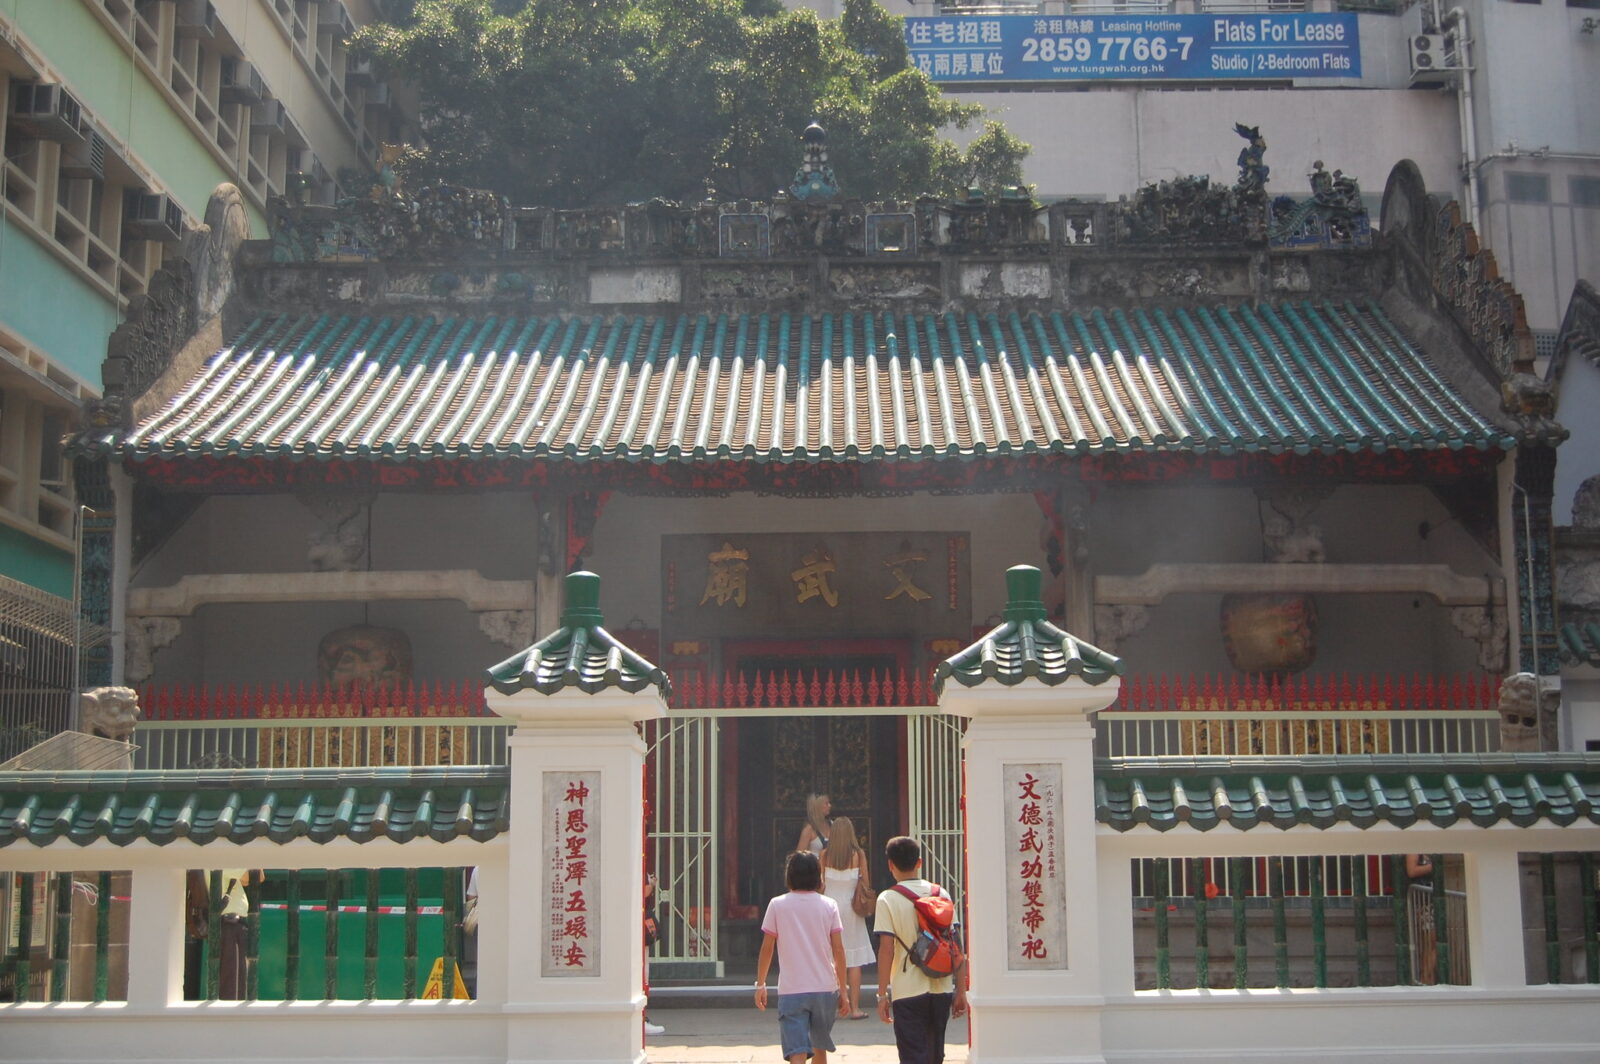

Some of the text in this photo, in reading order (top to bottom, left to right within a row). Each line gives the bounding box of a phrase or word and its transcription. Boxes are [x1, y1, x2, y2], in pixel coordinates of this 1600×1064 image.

[904, 21, 1002, 44] 住宅招租
[1101, 20, 1181, 34] Leasing Hotline
[1214, 18, 1345, 42] Flats For Lease
[1021, 36, 1194, 62] 2859 7766-7
[1052, 64, 1165, 74] www.tungwah.org.hk
[1211, 54, 1249, 70] Studio
[1257, 53, 1320, 70] 2-Bedroom
[1322, 53, 1350, 69] Flats
[1018, 773, 1047, 960] 文德武功雙帝祀
